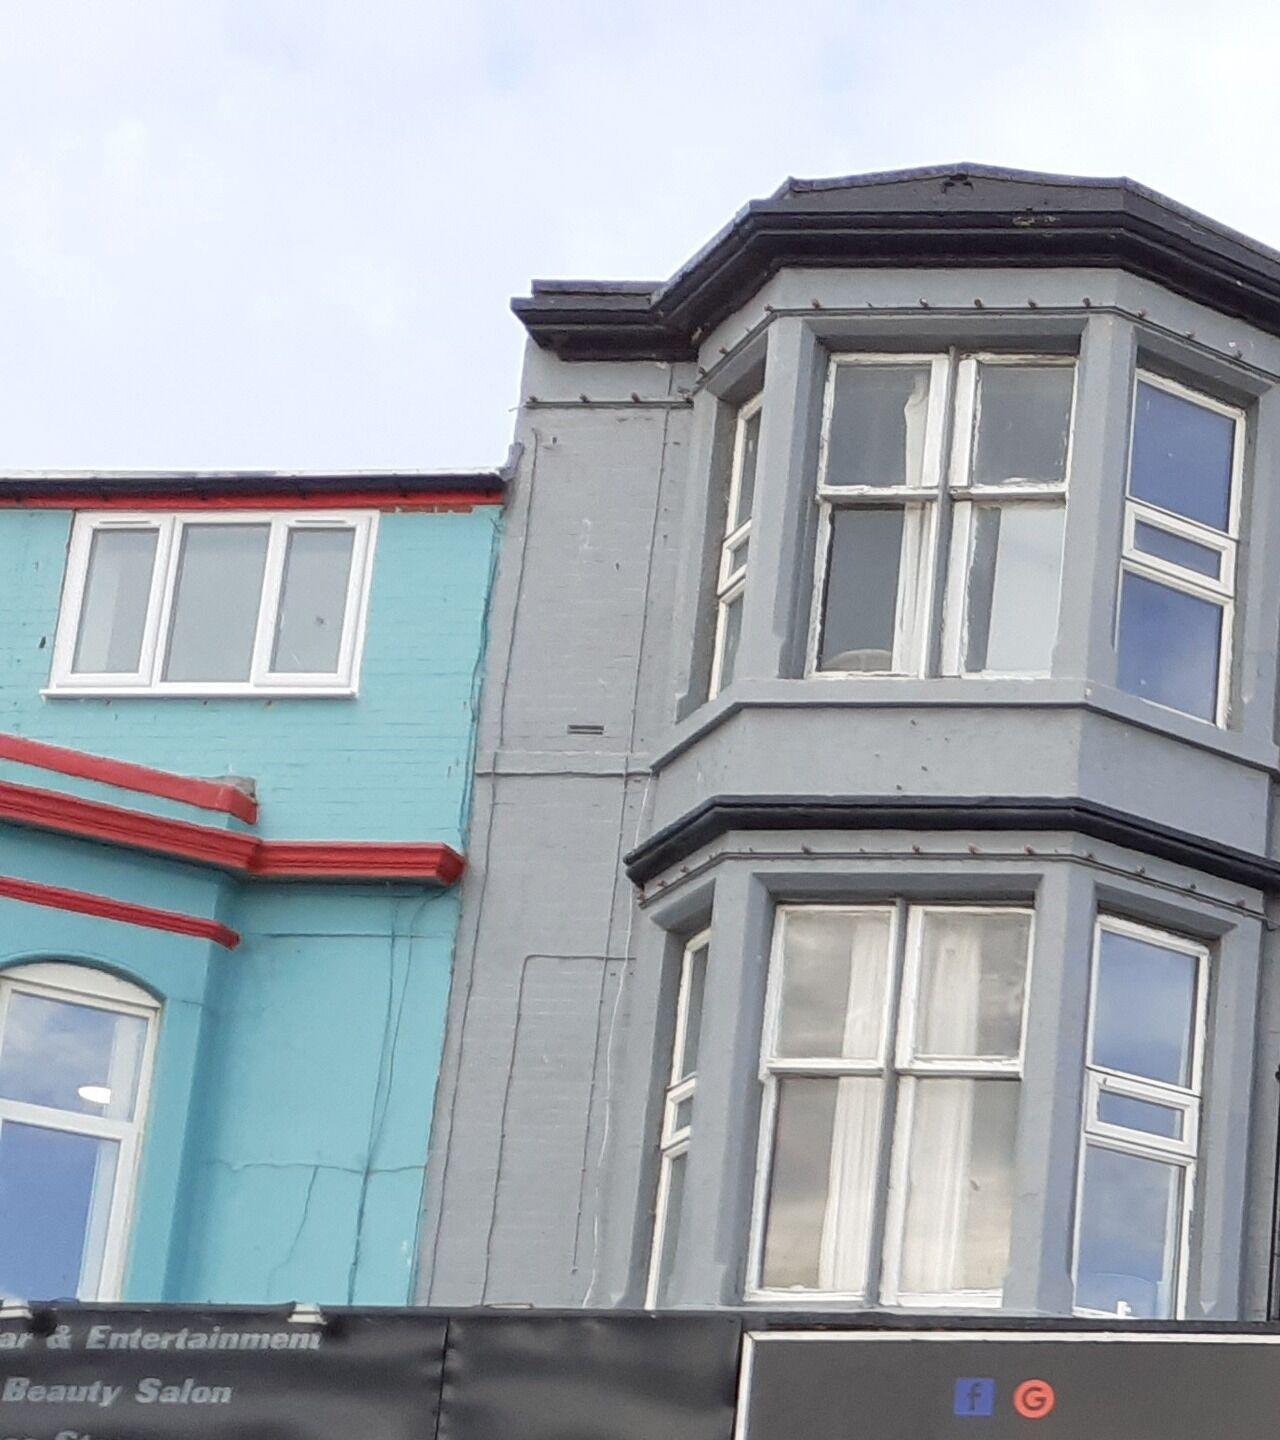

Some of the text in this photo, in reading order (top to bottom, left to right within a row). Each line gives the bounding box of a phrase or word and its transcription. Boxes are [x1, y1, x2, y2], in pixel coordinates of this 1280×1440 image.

[46, 1325, 72, 1349] &
[85, 1325, 322, 1350] Entertainment
[1, 1377, 234, 1407] Beauty Salon
